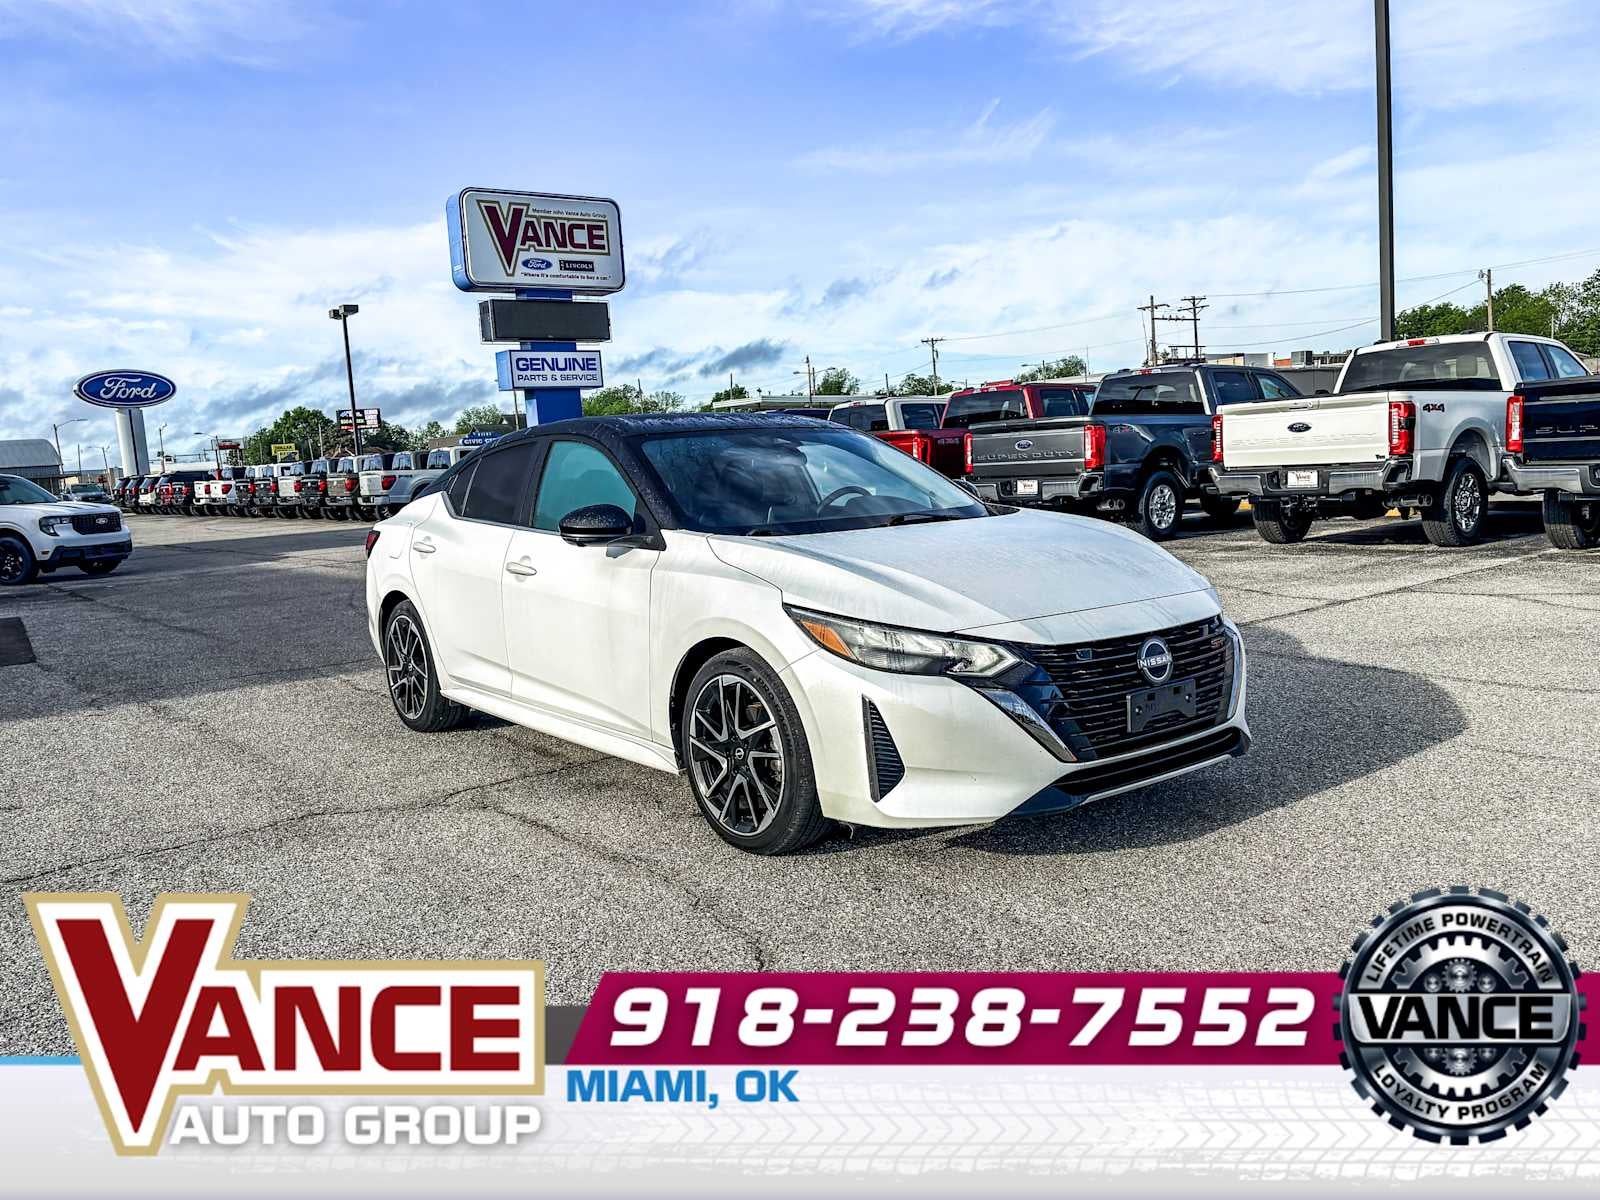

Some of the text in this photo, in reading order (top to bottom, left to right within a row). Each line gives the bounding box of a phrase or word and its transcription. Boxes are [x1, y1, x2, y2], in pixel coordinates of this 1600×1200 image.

[483, 205, 606, 269] VANCE
[527, 260, 547, 269] Ford
[516, 357, 597, 371] GENUINE
[560, 373, 597, 381] SERVICE
[100, 377, 157, 399] Ford
[977, 449, 1075, 461] SUPER DUTY
